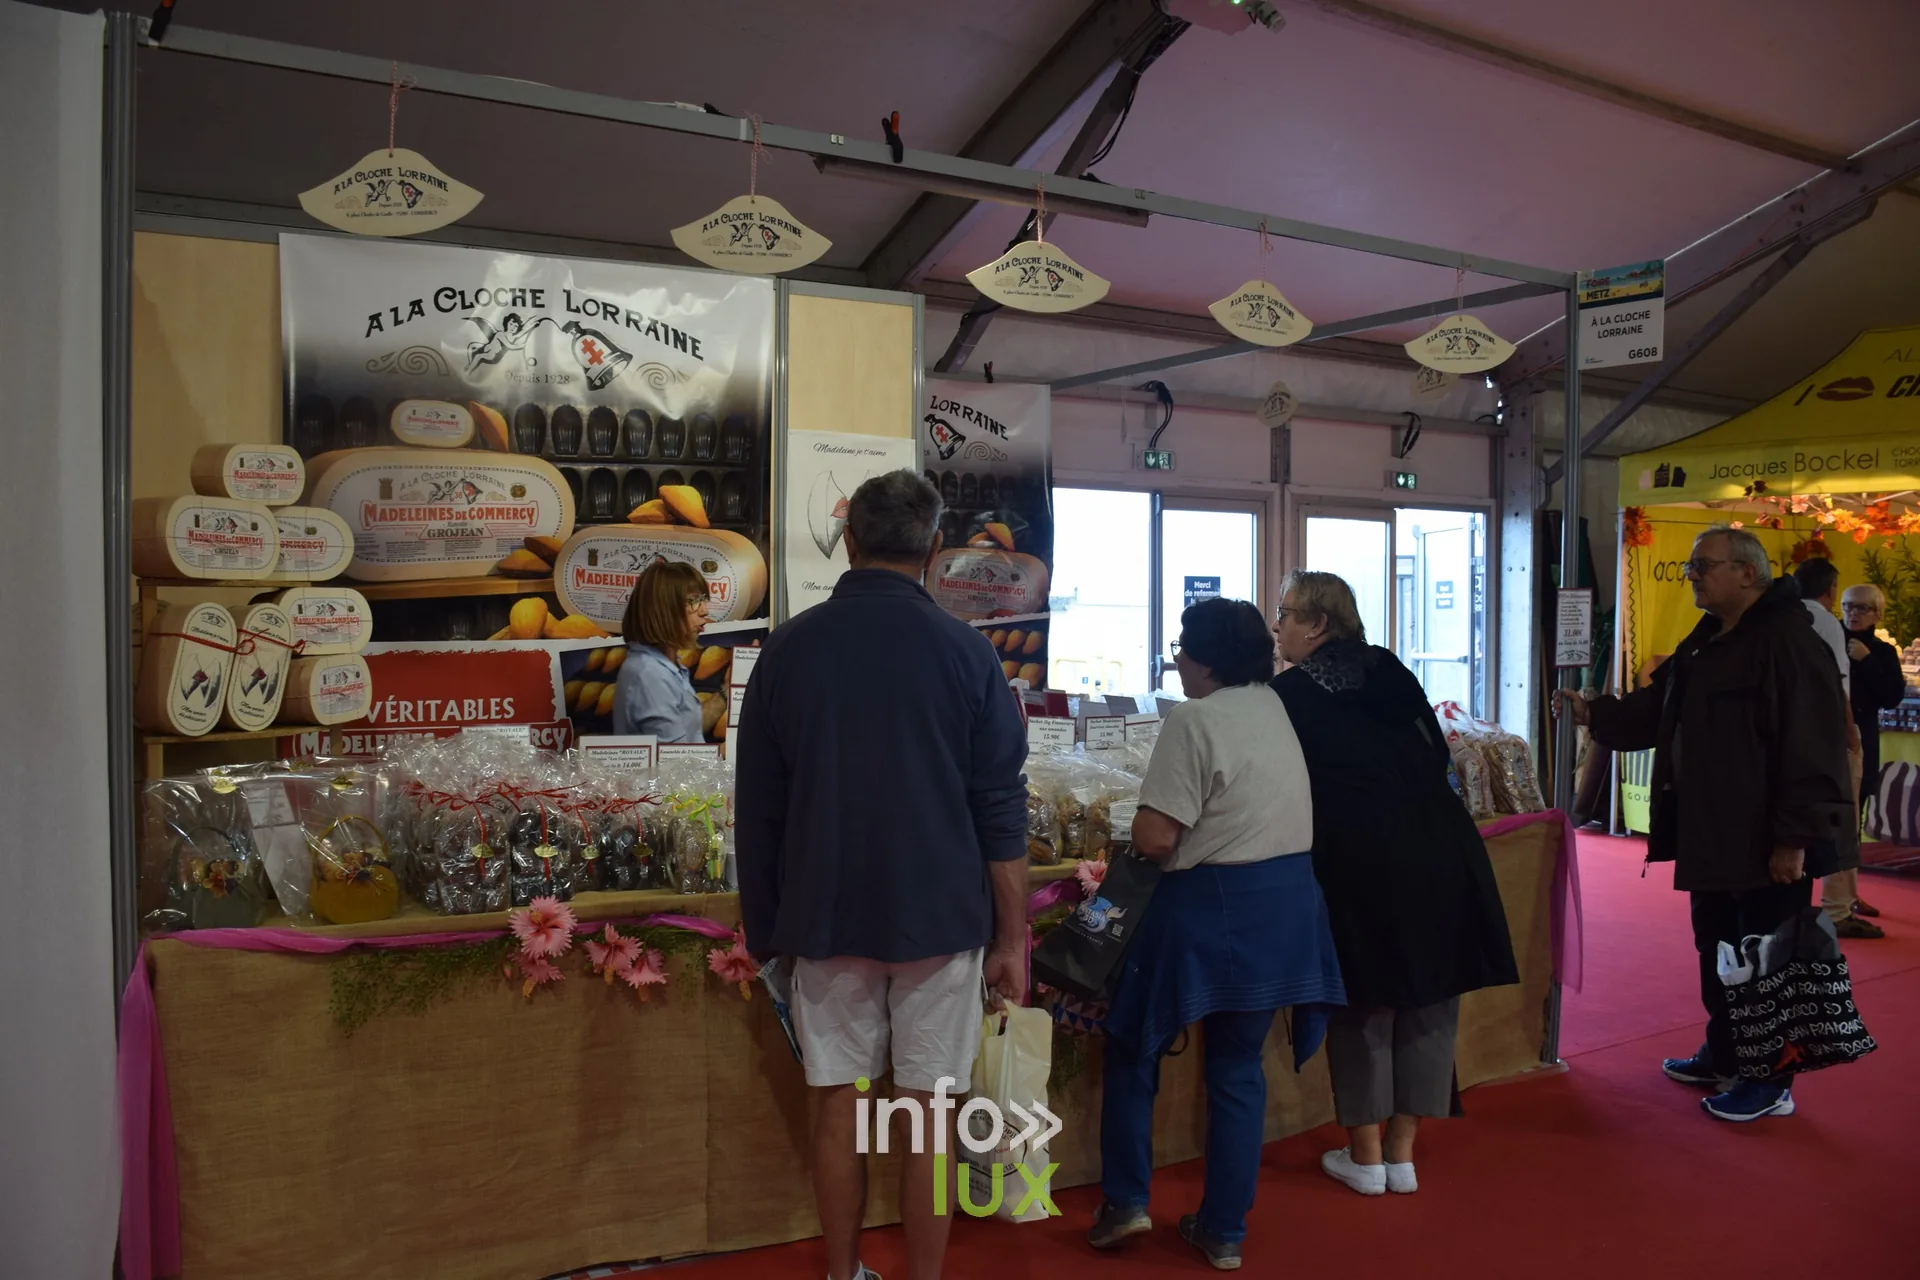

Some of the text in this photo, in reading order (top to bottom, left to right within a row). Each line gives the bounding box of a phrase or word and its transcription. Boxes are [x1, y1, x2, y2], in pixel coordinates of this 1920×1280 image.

[334, 167, 449, 195] A LA CLOCHE LORRAINE
[702, 212, 803, 238] A LA CLOCHE LORRAINE
[994, 257, 1084, 282] A LA CLOCHE LORRAINE
[1586, 288, 1610, 300] METZ
[1242, 293, 1265, 302] CLOCHE
[1267, 296, 1295, 320] LORRAINE
[365, 286, 704, 361] A LA CLOCHE LORRAINE
[1591, 310, 1651, 328] À LA CLOCHE
[1439, 328, 1462, 337] CLOCHE
[1465, 327, 1496, 345] LORRAINE
[1597, 324, 1644, 339] LORRAINE
[1628, 346, 1658, 360] G608
[505, 371, 571, 385] Depuis 1928
[930, 395, 1009, 441] LORRAINE
[813, 442, 887, 458] Madeleine je t'aime
[1708, 448, 1879, 484] Jacques Bockel
[408, 478, 419, 488] LA
[422, 471, 458, 482] CLOCHE
[463, 471, 506, 491] LORRAINE
[364, 503, 536, 527] MADELEINES DE COMMERCY
[427, 528, 485, 538] GROJEAN
[280, 540, 324, 553] OMMERCY
[610, 549, 620, 557] LA
[621, 544, 653, 554] CLOCHE
[656, 544, 696, 565] LORRAINE
[802, 580, 822, 591] Mon
[366, 696, 516, 723] VÉRITABLES
[1628, 793, 1650, 802] GOU
